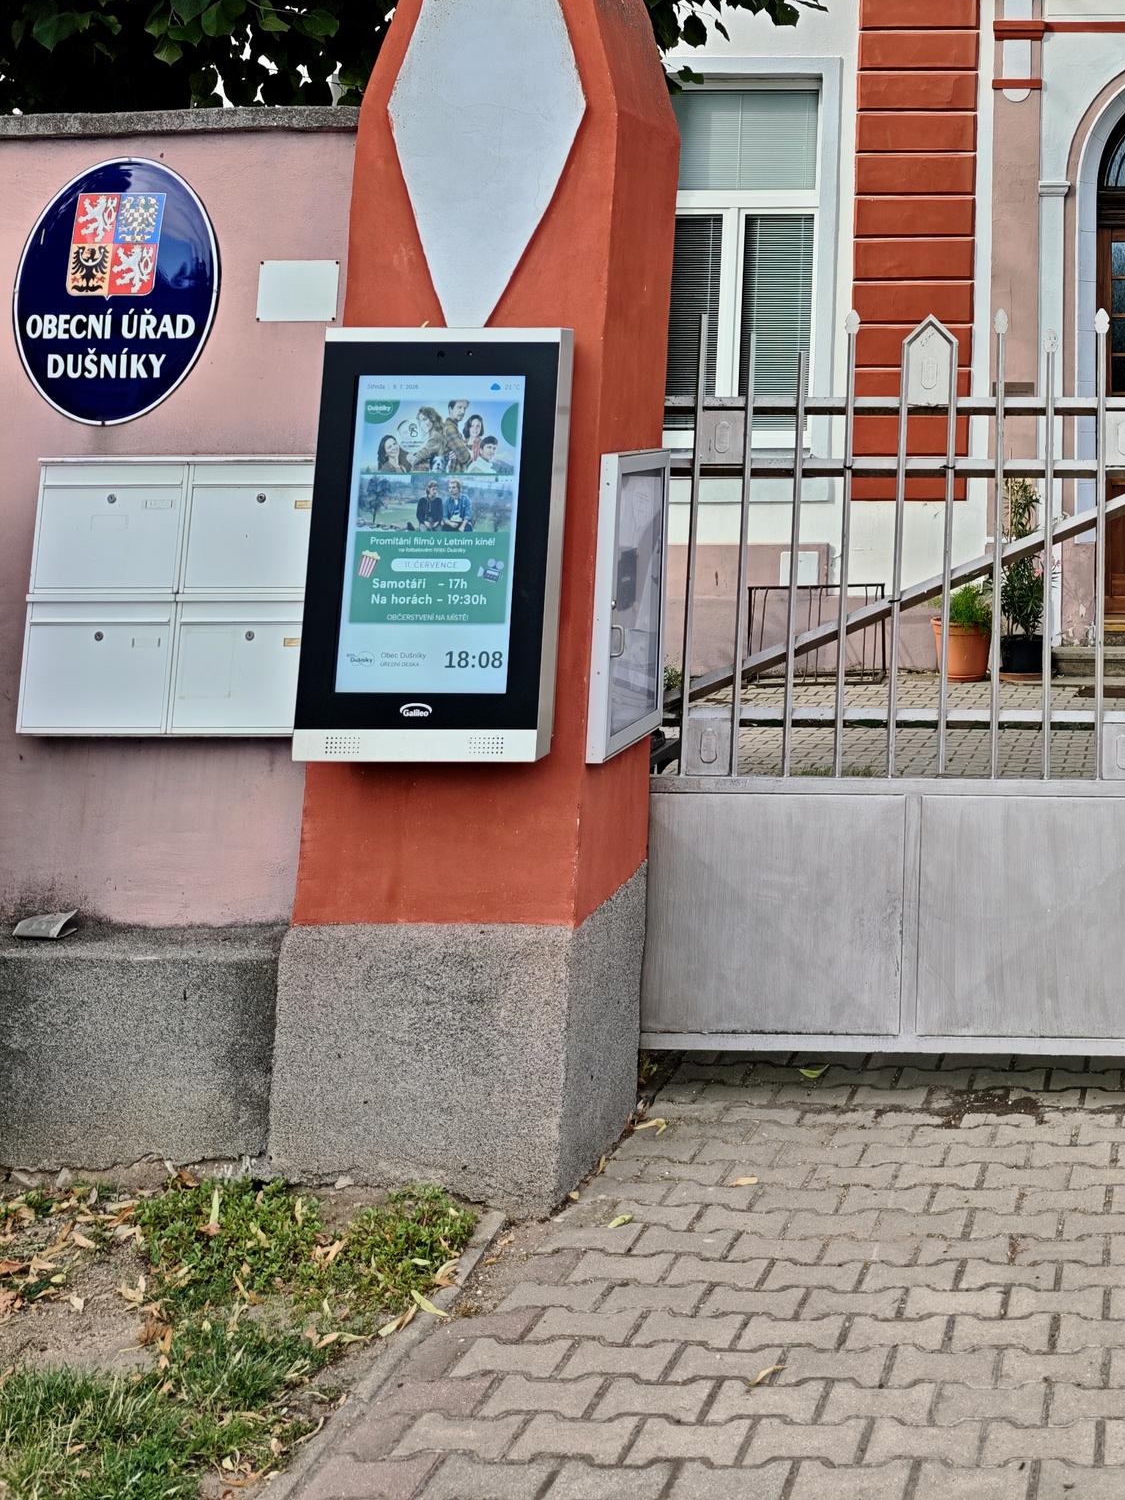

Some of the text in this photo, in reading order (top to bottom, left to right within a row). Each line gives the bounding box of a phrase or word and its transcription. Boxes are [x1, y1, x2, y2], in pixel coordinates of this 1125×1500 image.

[26, 308, 196, 339] OBECNÍ ÚŘAD
[47, 347, 167, 379] DUŠNÍKY
[370, 536, 411, 546] Promítání
[413, 536, 434, 546] filmů
[444, 536, 473, 546] Letním
[475, 536, 496, 546] kině!
[413, 560, 457, 569] ČERVENCE
[372, 578, 426, 589] Samotáři
[449, 578, 468, 589] 17h
[370, 594, 387, 605] Na
[391, 594, 433, 605] horách
[447, 594, 487, 605] 19:30h
[386, 613, 435, 621] OBČERSTVENÍ
[446, 613, 469, 621] MÍSTĚ!
[380, 650, 503, 669] Obec Dušníky 18:08
[402, 708, 430, 717] Galileo
